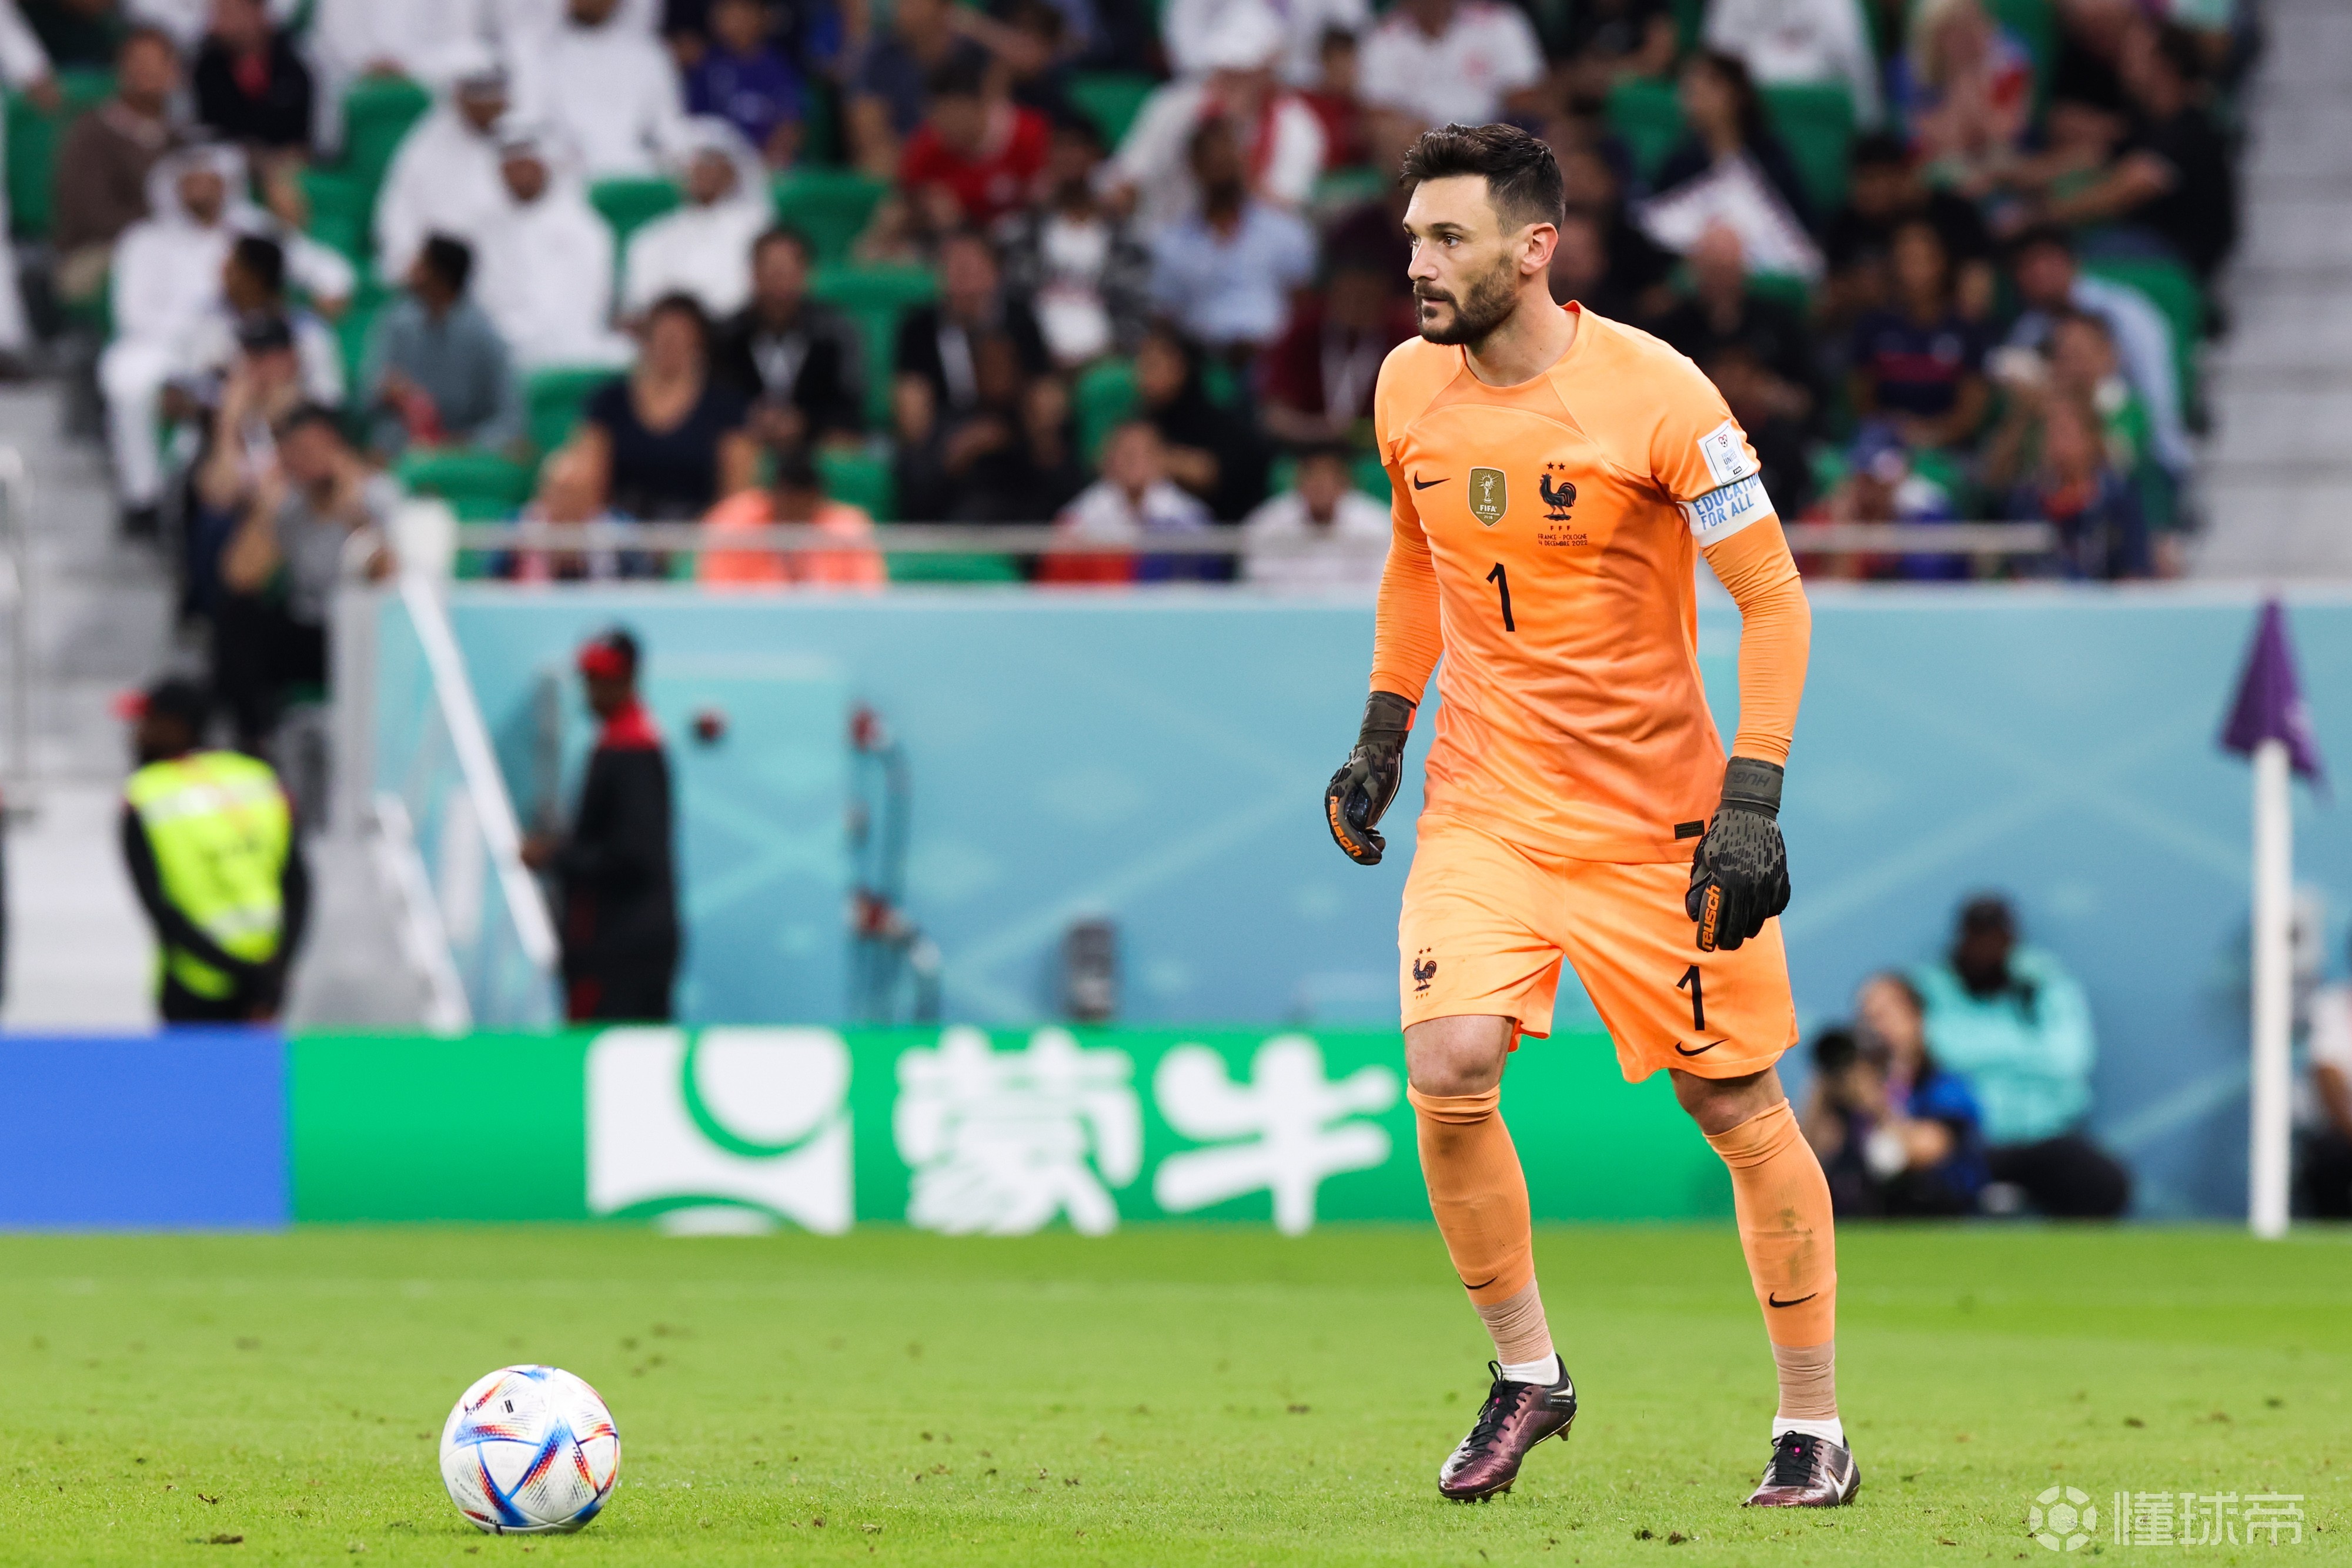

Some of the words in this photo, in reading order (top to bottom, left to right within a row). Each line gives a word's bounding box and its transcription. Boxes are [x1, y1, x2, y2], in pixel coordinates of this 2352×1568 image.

[1700, 508, 1727, 530] FOR
[1730, 494, 1754, 517] ALL
[1486, 562, 1515, 631] 1
[1702, 884, 1720, 951] reusch
[1676, 965, 1705, 1031] 1
[894, 1028, 1401, 1236] 蒙牛
